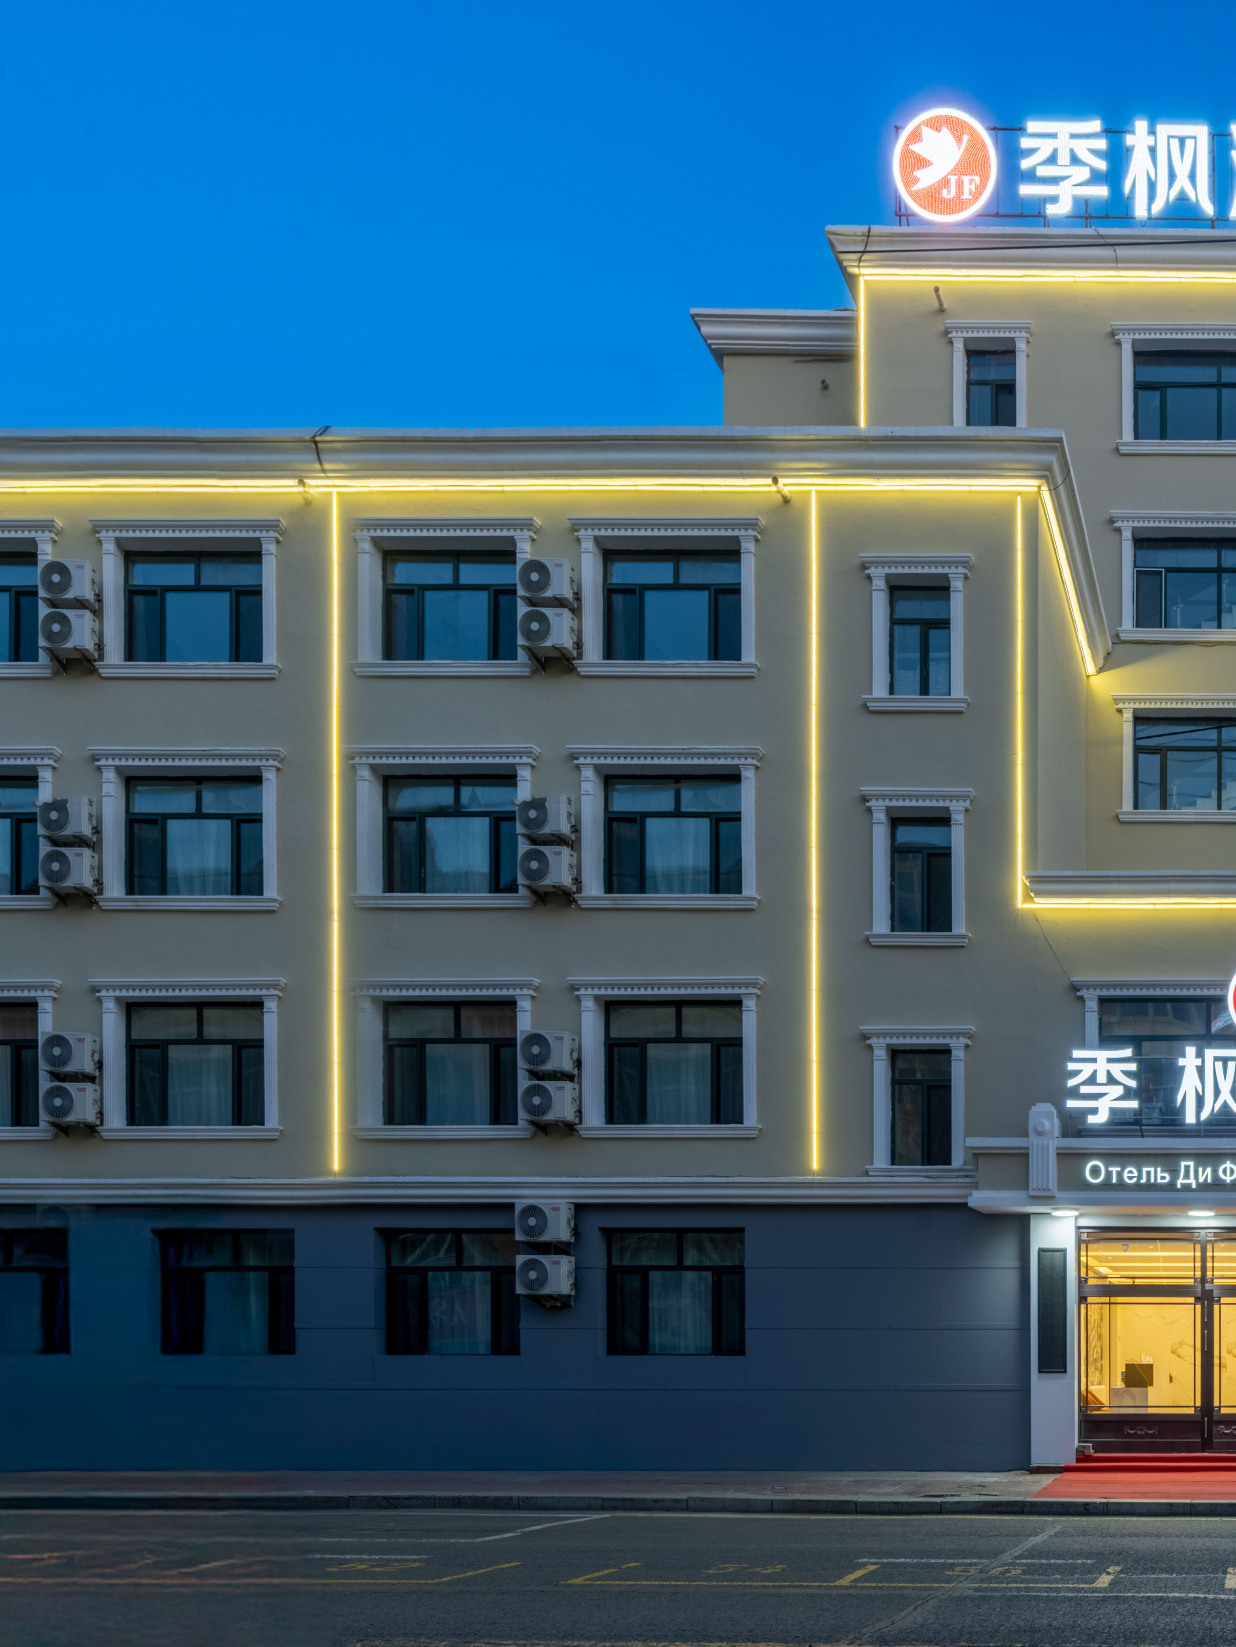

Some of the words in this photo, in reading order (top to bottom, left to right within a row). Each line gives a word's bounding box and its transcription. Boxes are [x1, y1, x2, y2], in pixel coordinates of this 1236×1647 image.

[942, 174, 980, 199] JF
[1085, 1160, 1170, 1184] Отель
[1177, 1160, 1212, 1189] Ди
